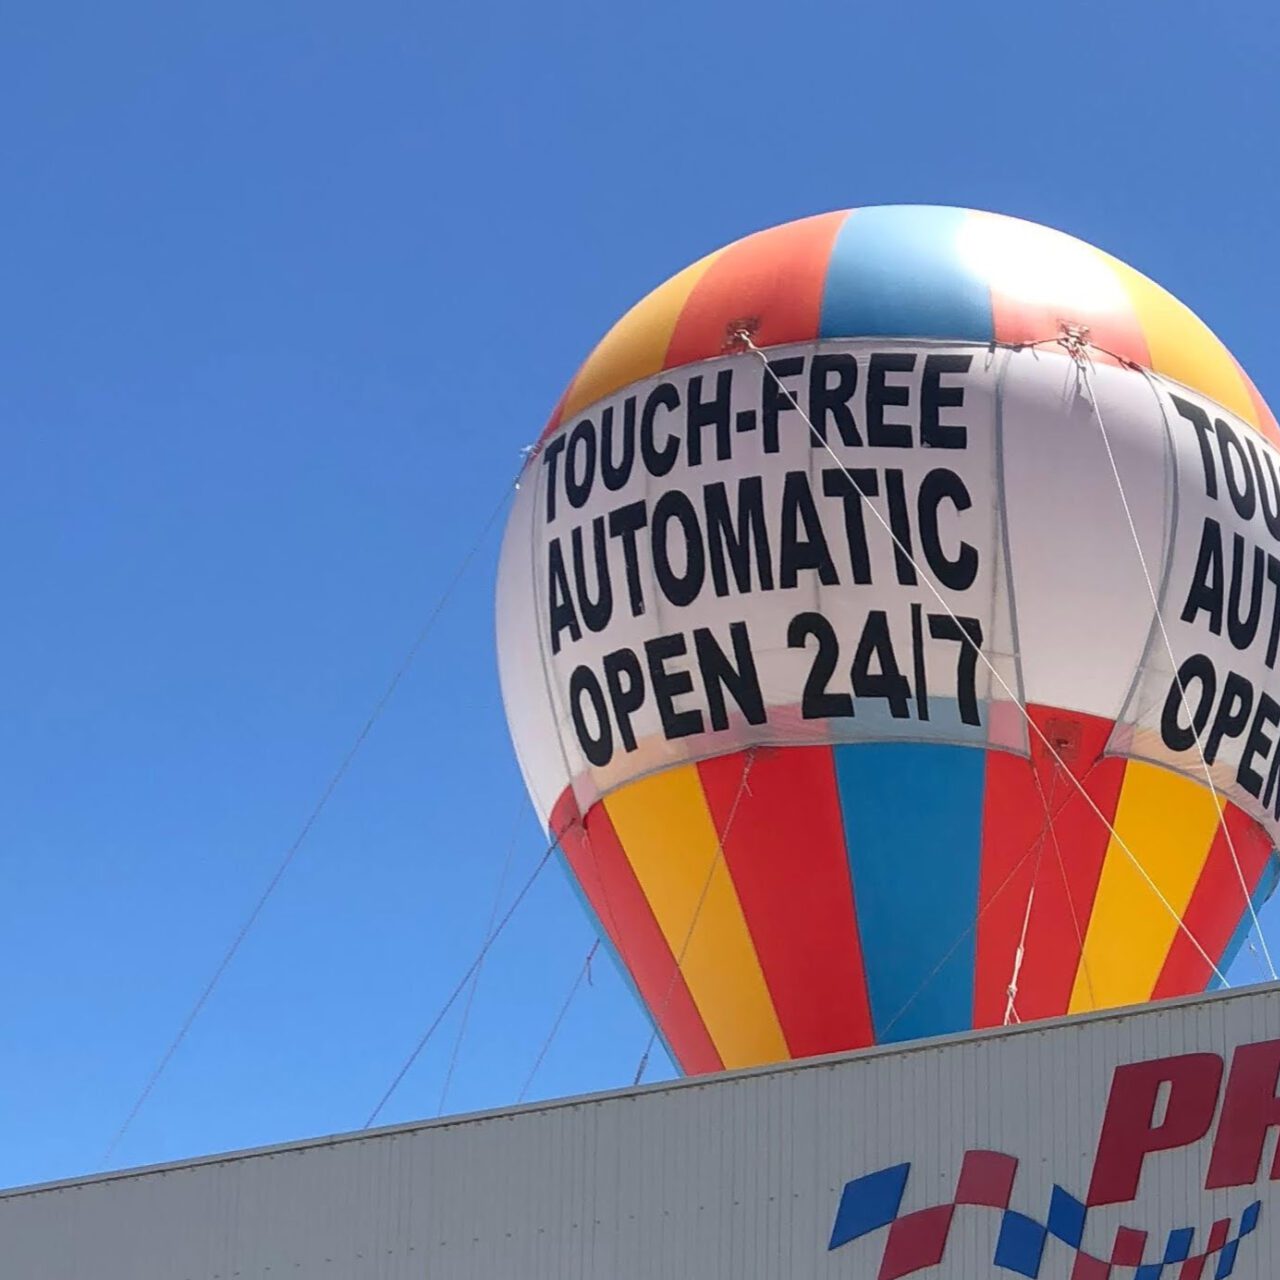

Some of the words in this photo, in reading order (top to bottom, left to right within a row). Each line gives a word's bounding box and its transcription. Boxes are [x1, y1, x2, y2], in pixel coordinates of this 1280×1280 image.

[542, 353, 974, 523] TOUCH-FREE
[547, 467, 979, 655] AUTOMATIC
[568, 622, 768, 767] OPEN
[786, 603, 984, 727] 24/7
